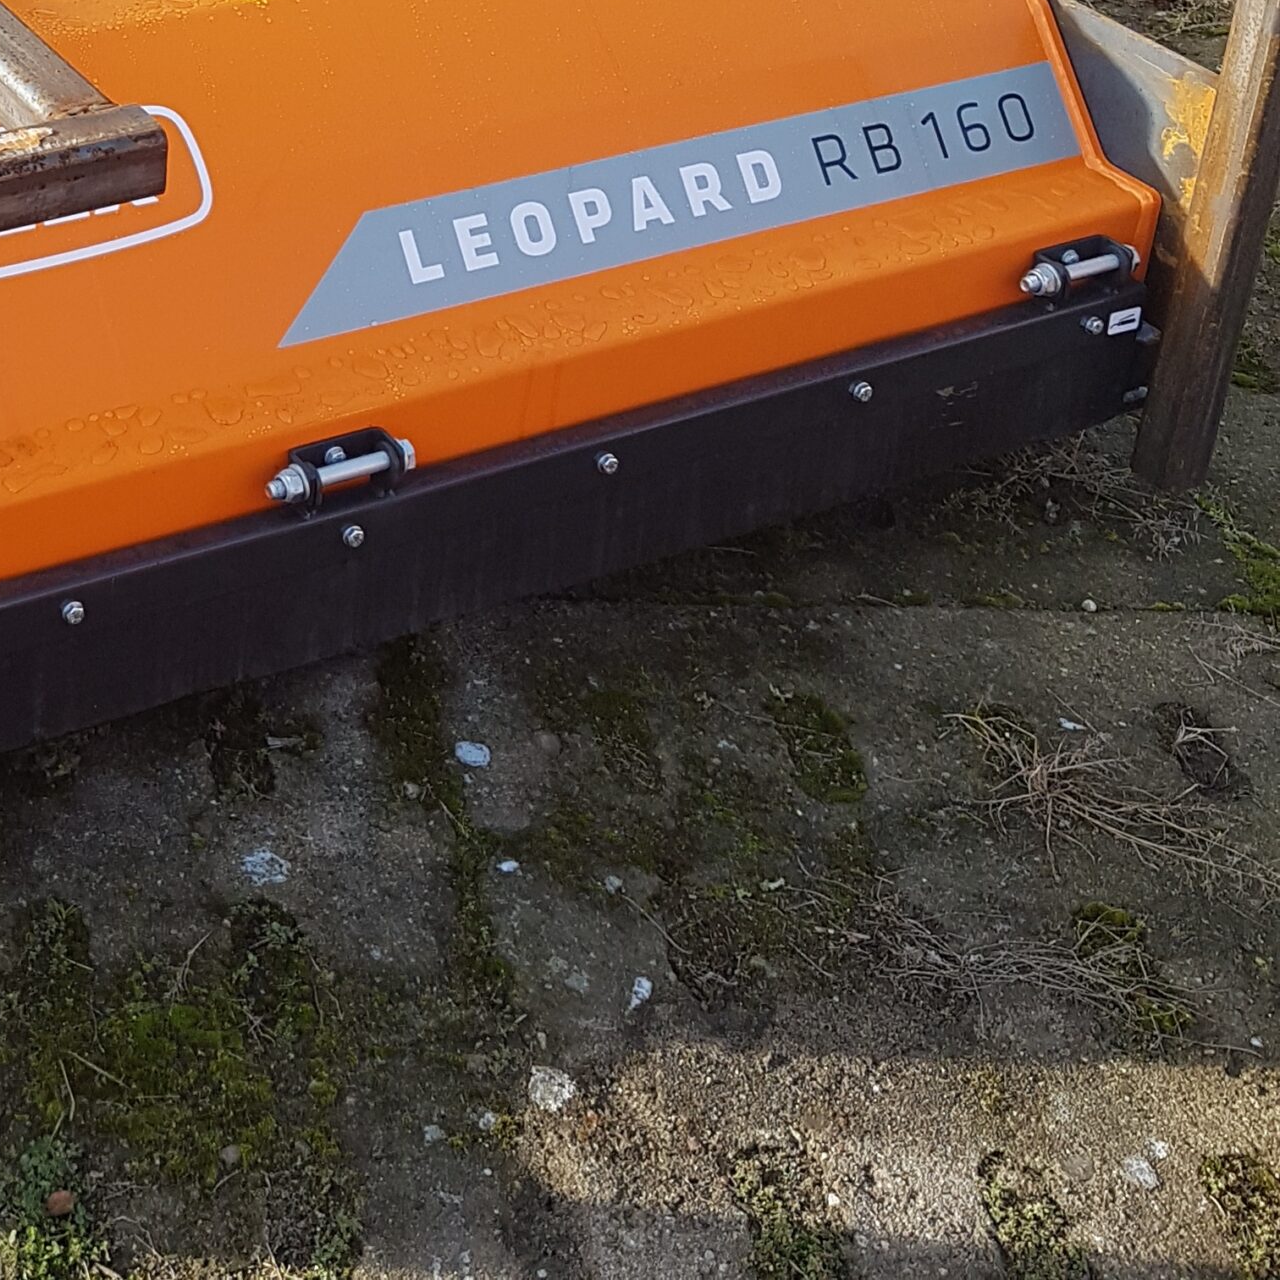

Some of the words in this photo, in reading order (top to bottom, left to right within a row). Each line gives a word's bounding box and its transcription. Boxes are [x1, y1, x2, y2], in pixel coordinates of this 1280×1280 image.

[398, 149, 784, 286] LEOPARD
[811, 122, 904, 187] RB
[921, 92, 1036, 160] 160
